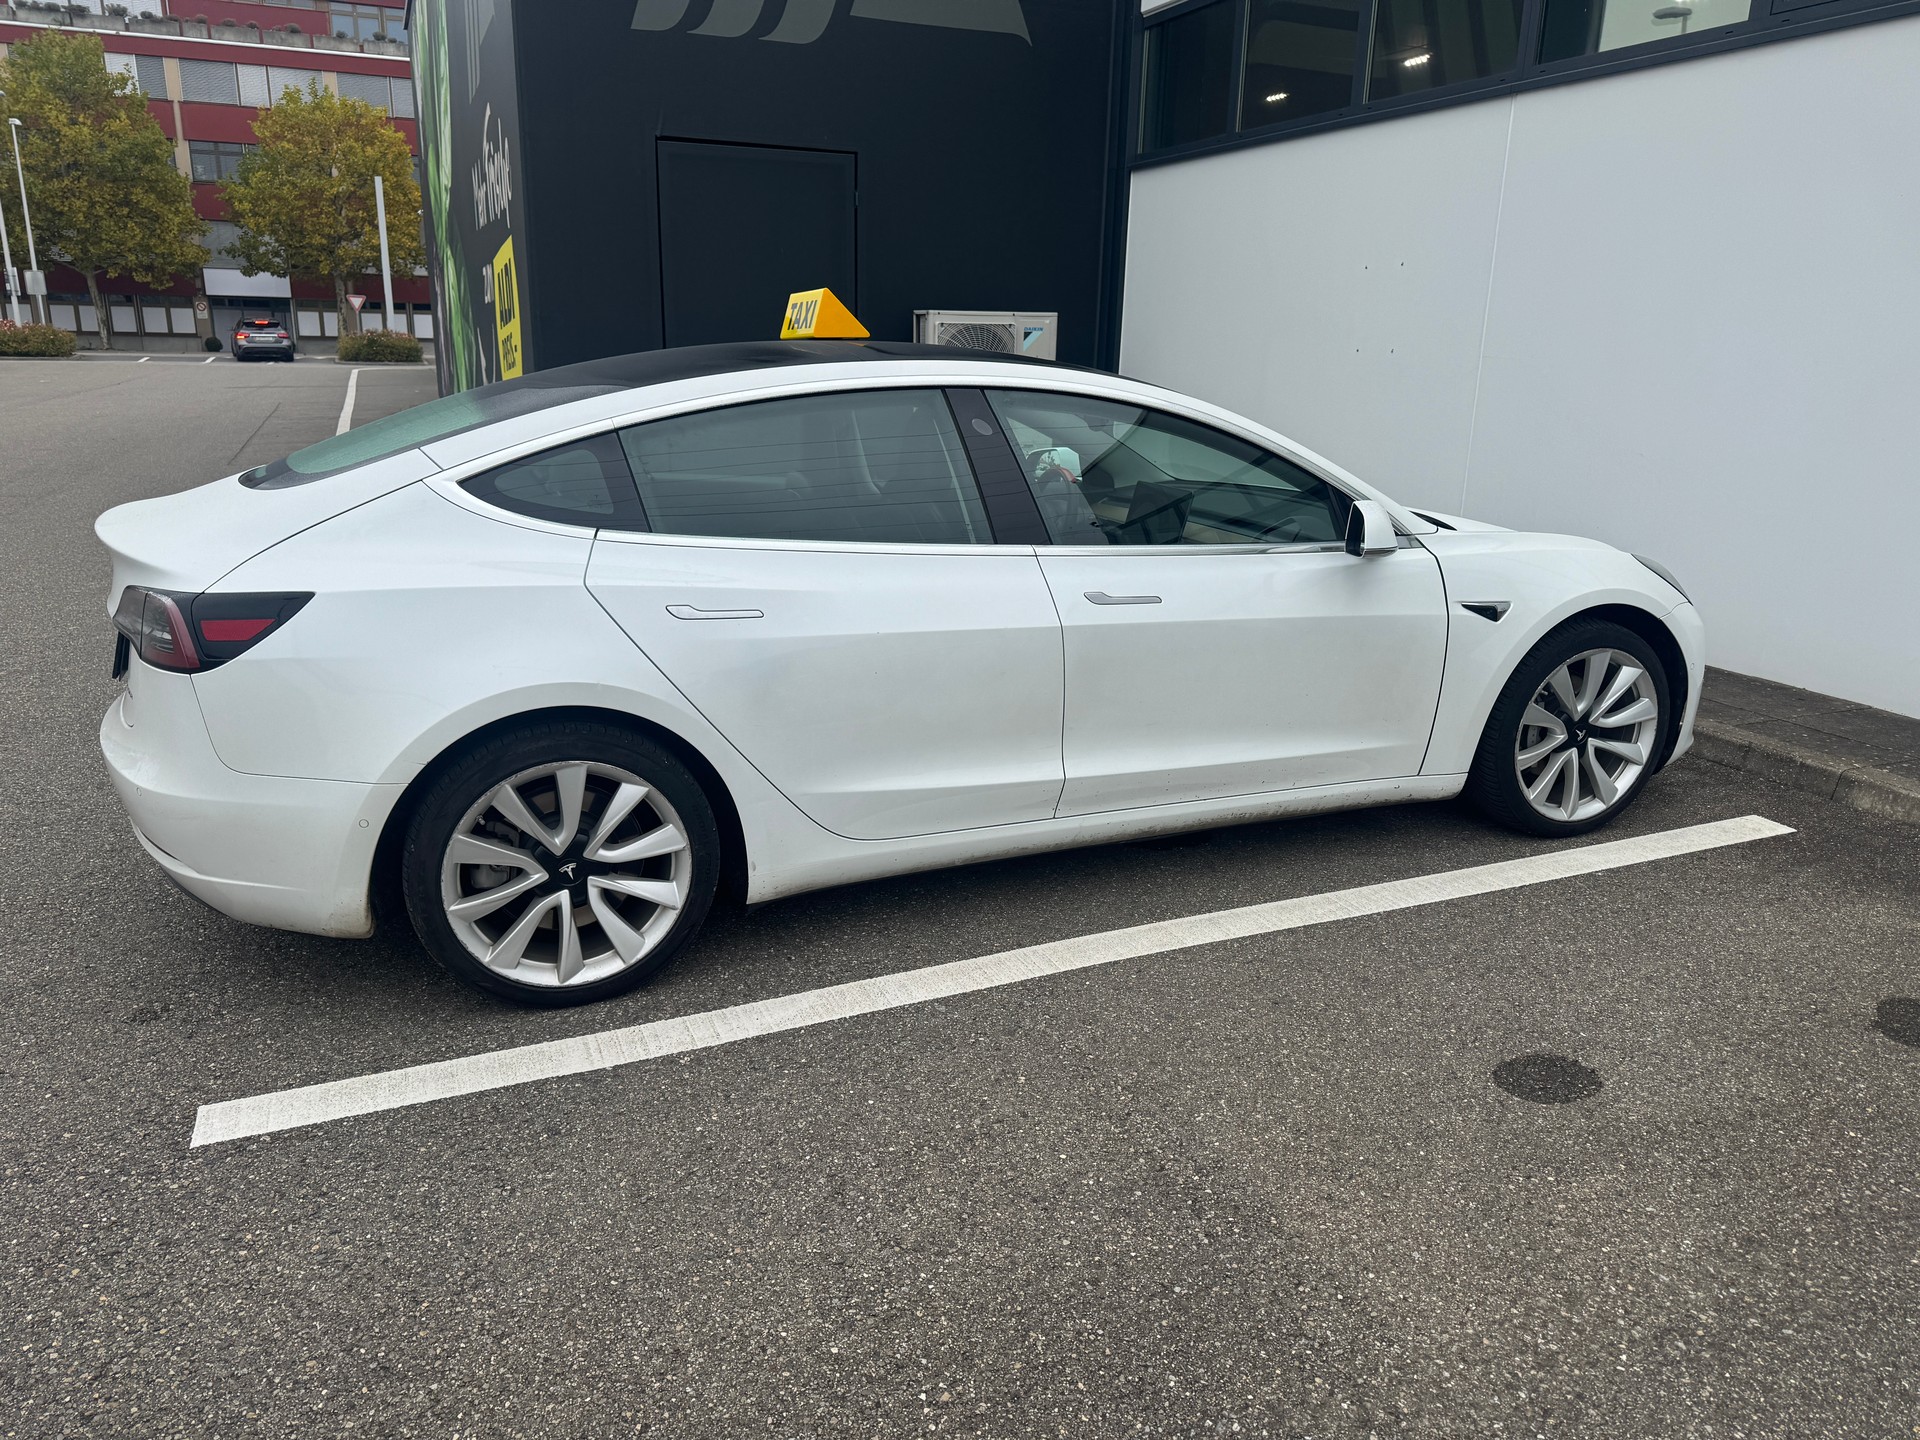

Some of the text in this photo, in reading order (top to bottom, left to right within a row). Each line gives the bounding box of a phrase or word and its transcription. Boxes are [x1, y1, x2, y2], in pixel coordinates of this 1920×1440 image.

[483, 102, 512, 229] Frische
[498, 258, 516, 330] ALDI
[787, 300, 818, 330] TAXI
